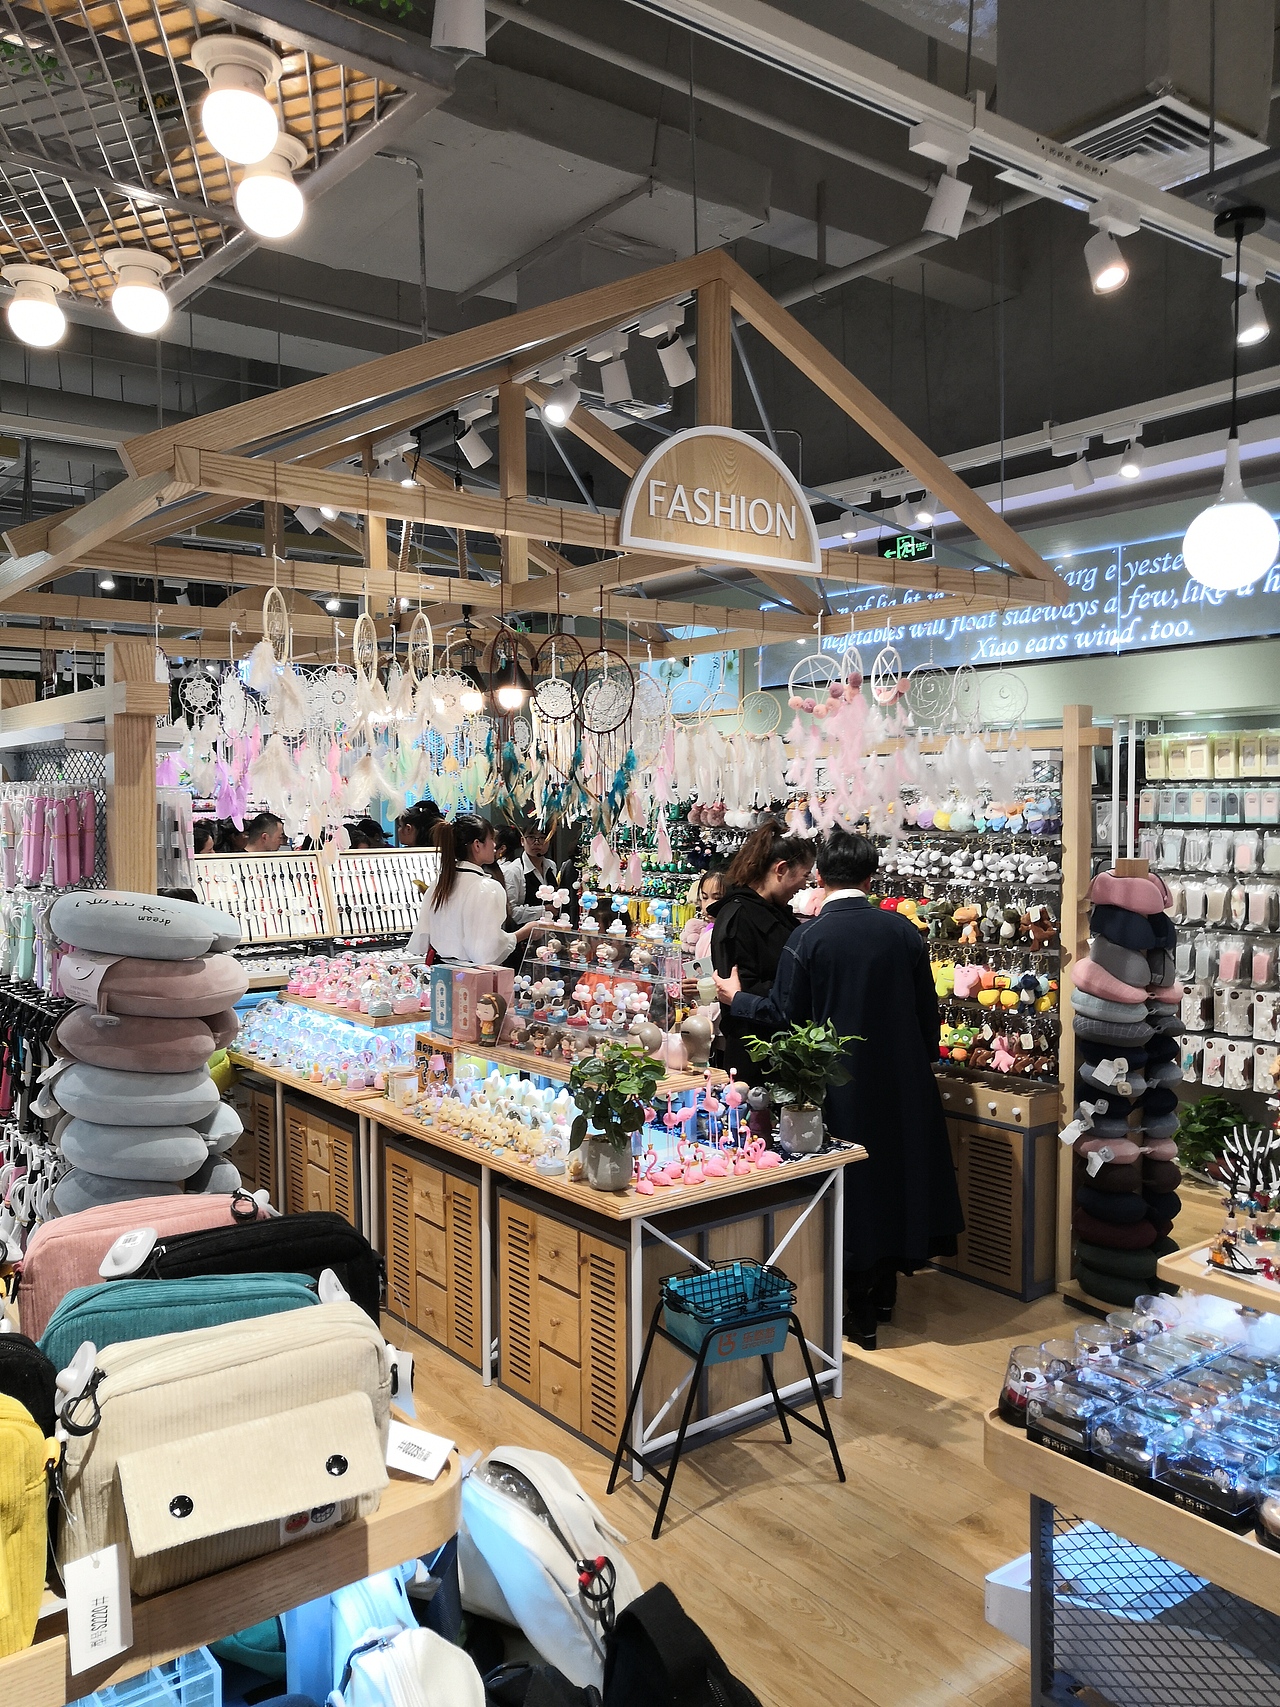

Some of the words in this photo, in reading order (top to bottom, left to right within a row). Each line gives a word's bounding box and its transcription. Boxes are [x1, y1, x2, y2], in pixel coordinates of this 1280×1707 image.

[649, 479, 796, 540] FASHION
[1120, 551, 1188, 586] yeste
[908, 617, 946, 640] will
[944, 611, 998, 641] float
[1001, 599, 1100, 626] sideways
[1103, 596, 1119, 615] a
[970, 637, 1020, 661] Xiao
[1025, 633, 1069, 654] ears
[1073, 616, 1142, 649] wind
[137, 914, 171, 927] dream
